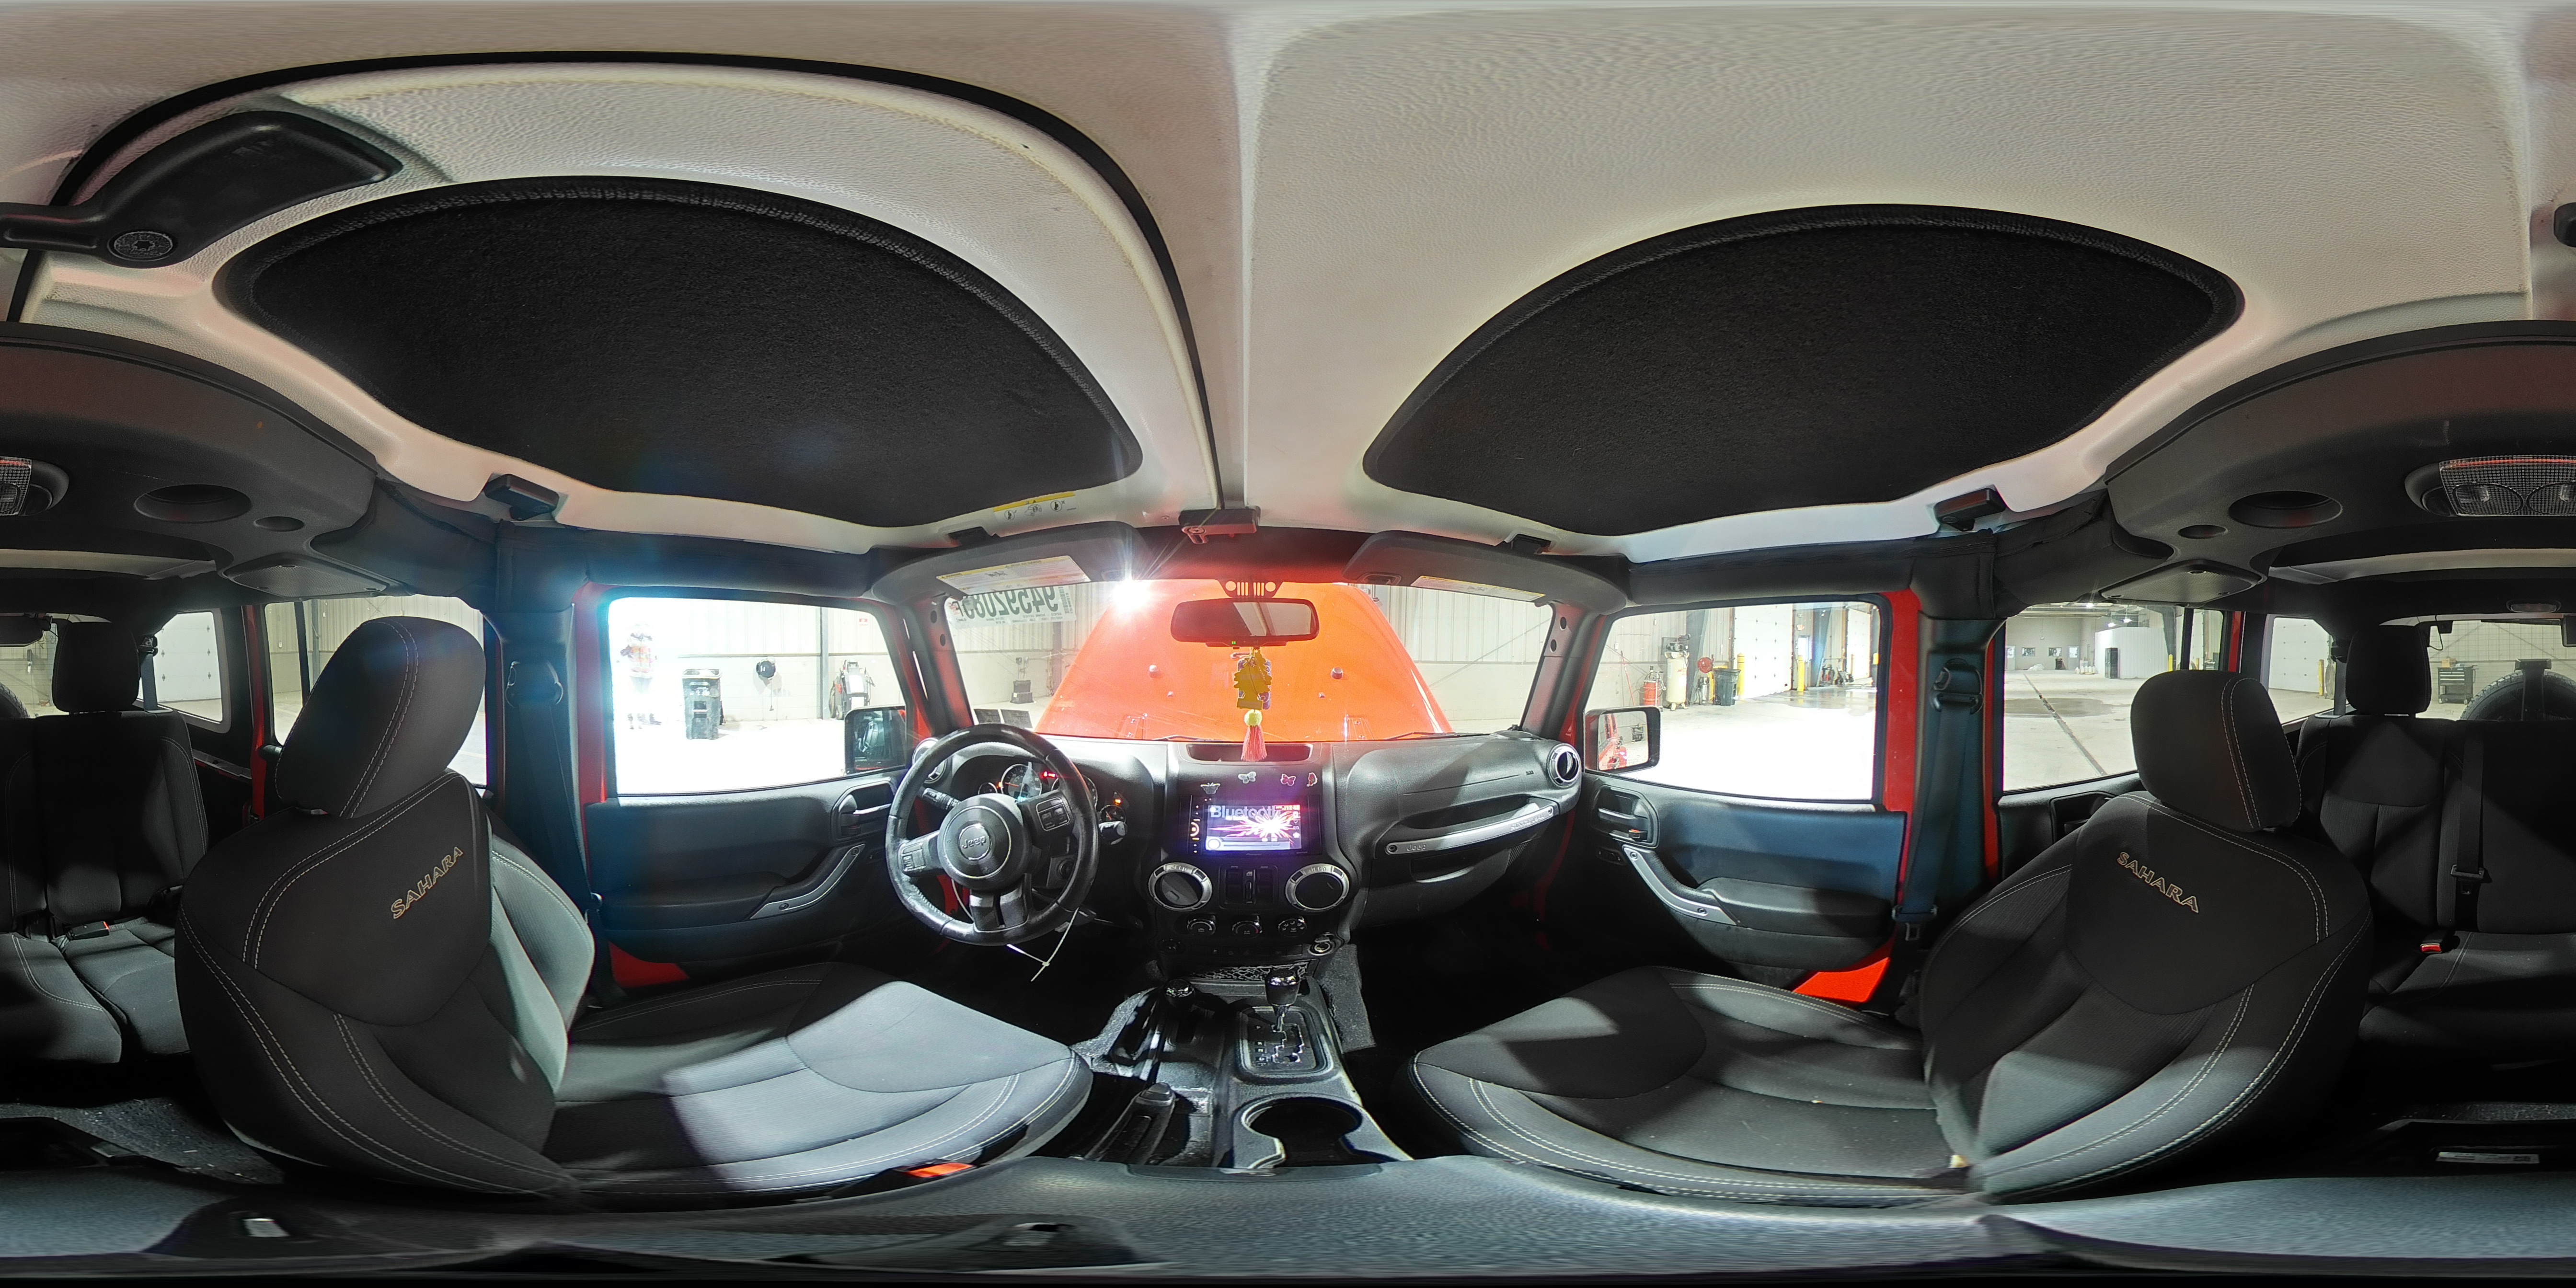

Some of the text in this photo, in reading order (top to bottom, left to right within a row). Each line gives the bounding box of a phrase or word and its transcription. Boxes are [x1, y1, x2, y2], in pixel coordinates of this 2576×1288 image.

[1210, 805, 1280, 818] Bluetooth
[961, 836, 986, 849] Jeep
[391, 846, 464, 920] SAHARA
[2116, 852, 2199, 913] SAHARA
